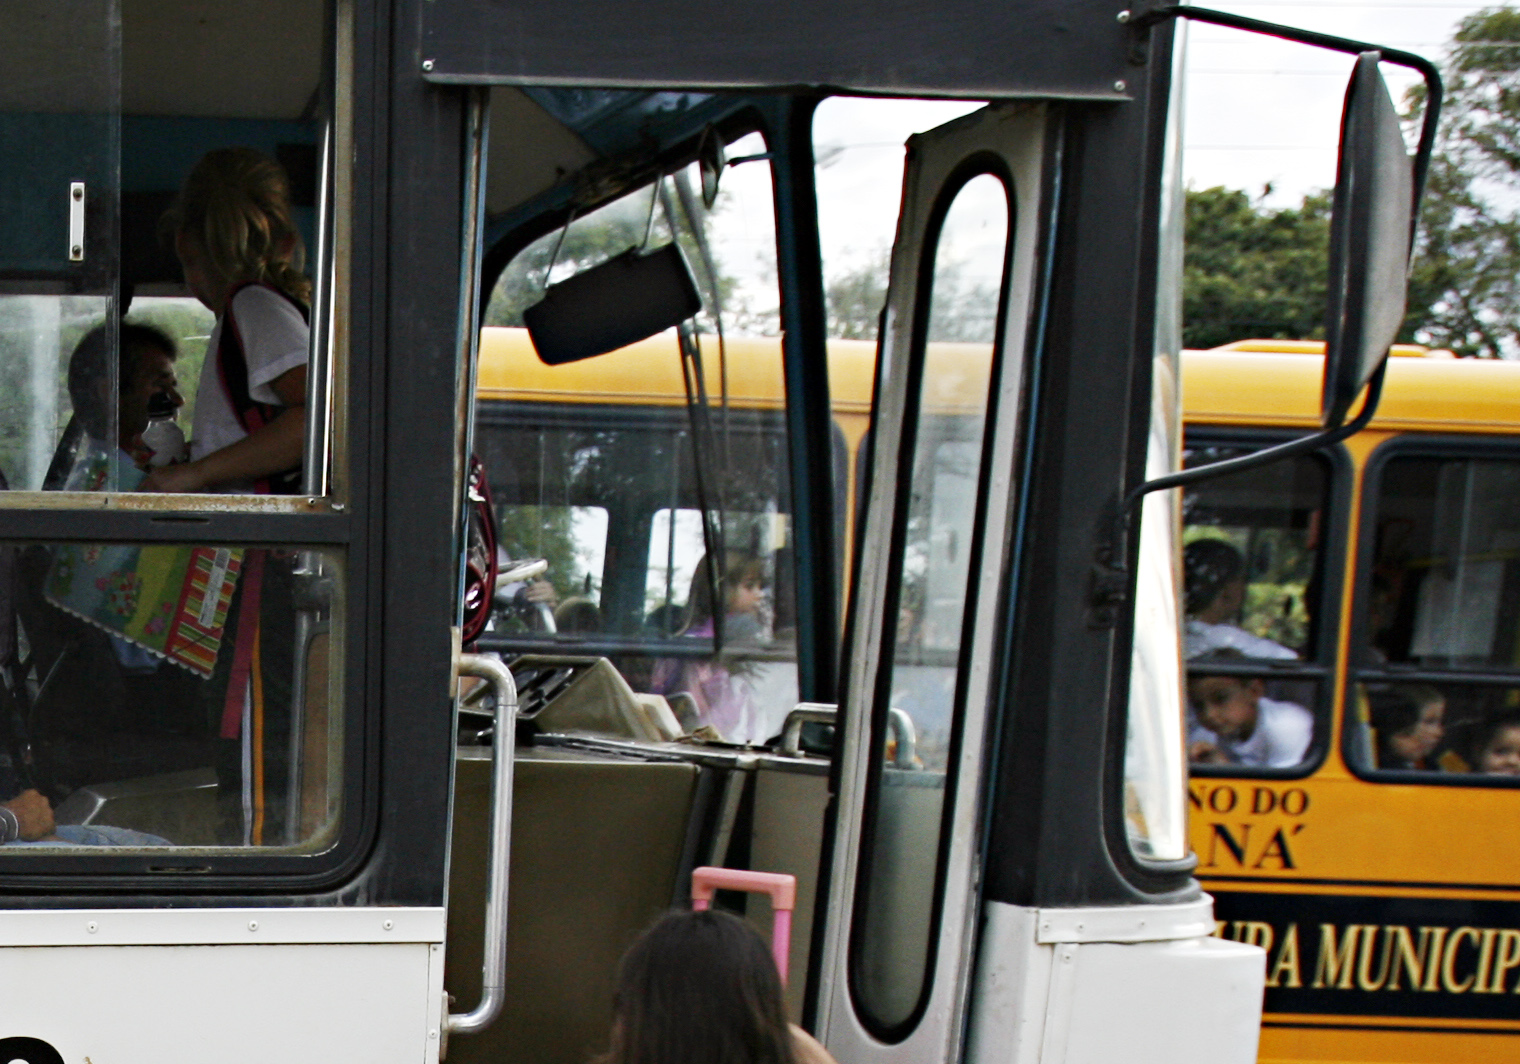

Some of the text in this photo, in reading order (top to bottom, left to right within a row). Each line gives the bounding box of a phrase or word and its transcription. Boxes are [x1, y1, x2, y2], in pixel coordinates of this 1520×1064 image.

[1250, 786, 1310, 816] DO
[1190, 822, 1306, 870] NÁ
[1312, 923, 1520, 994] MUNICIP
